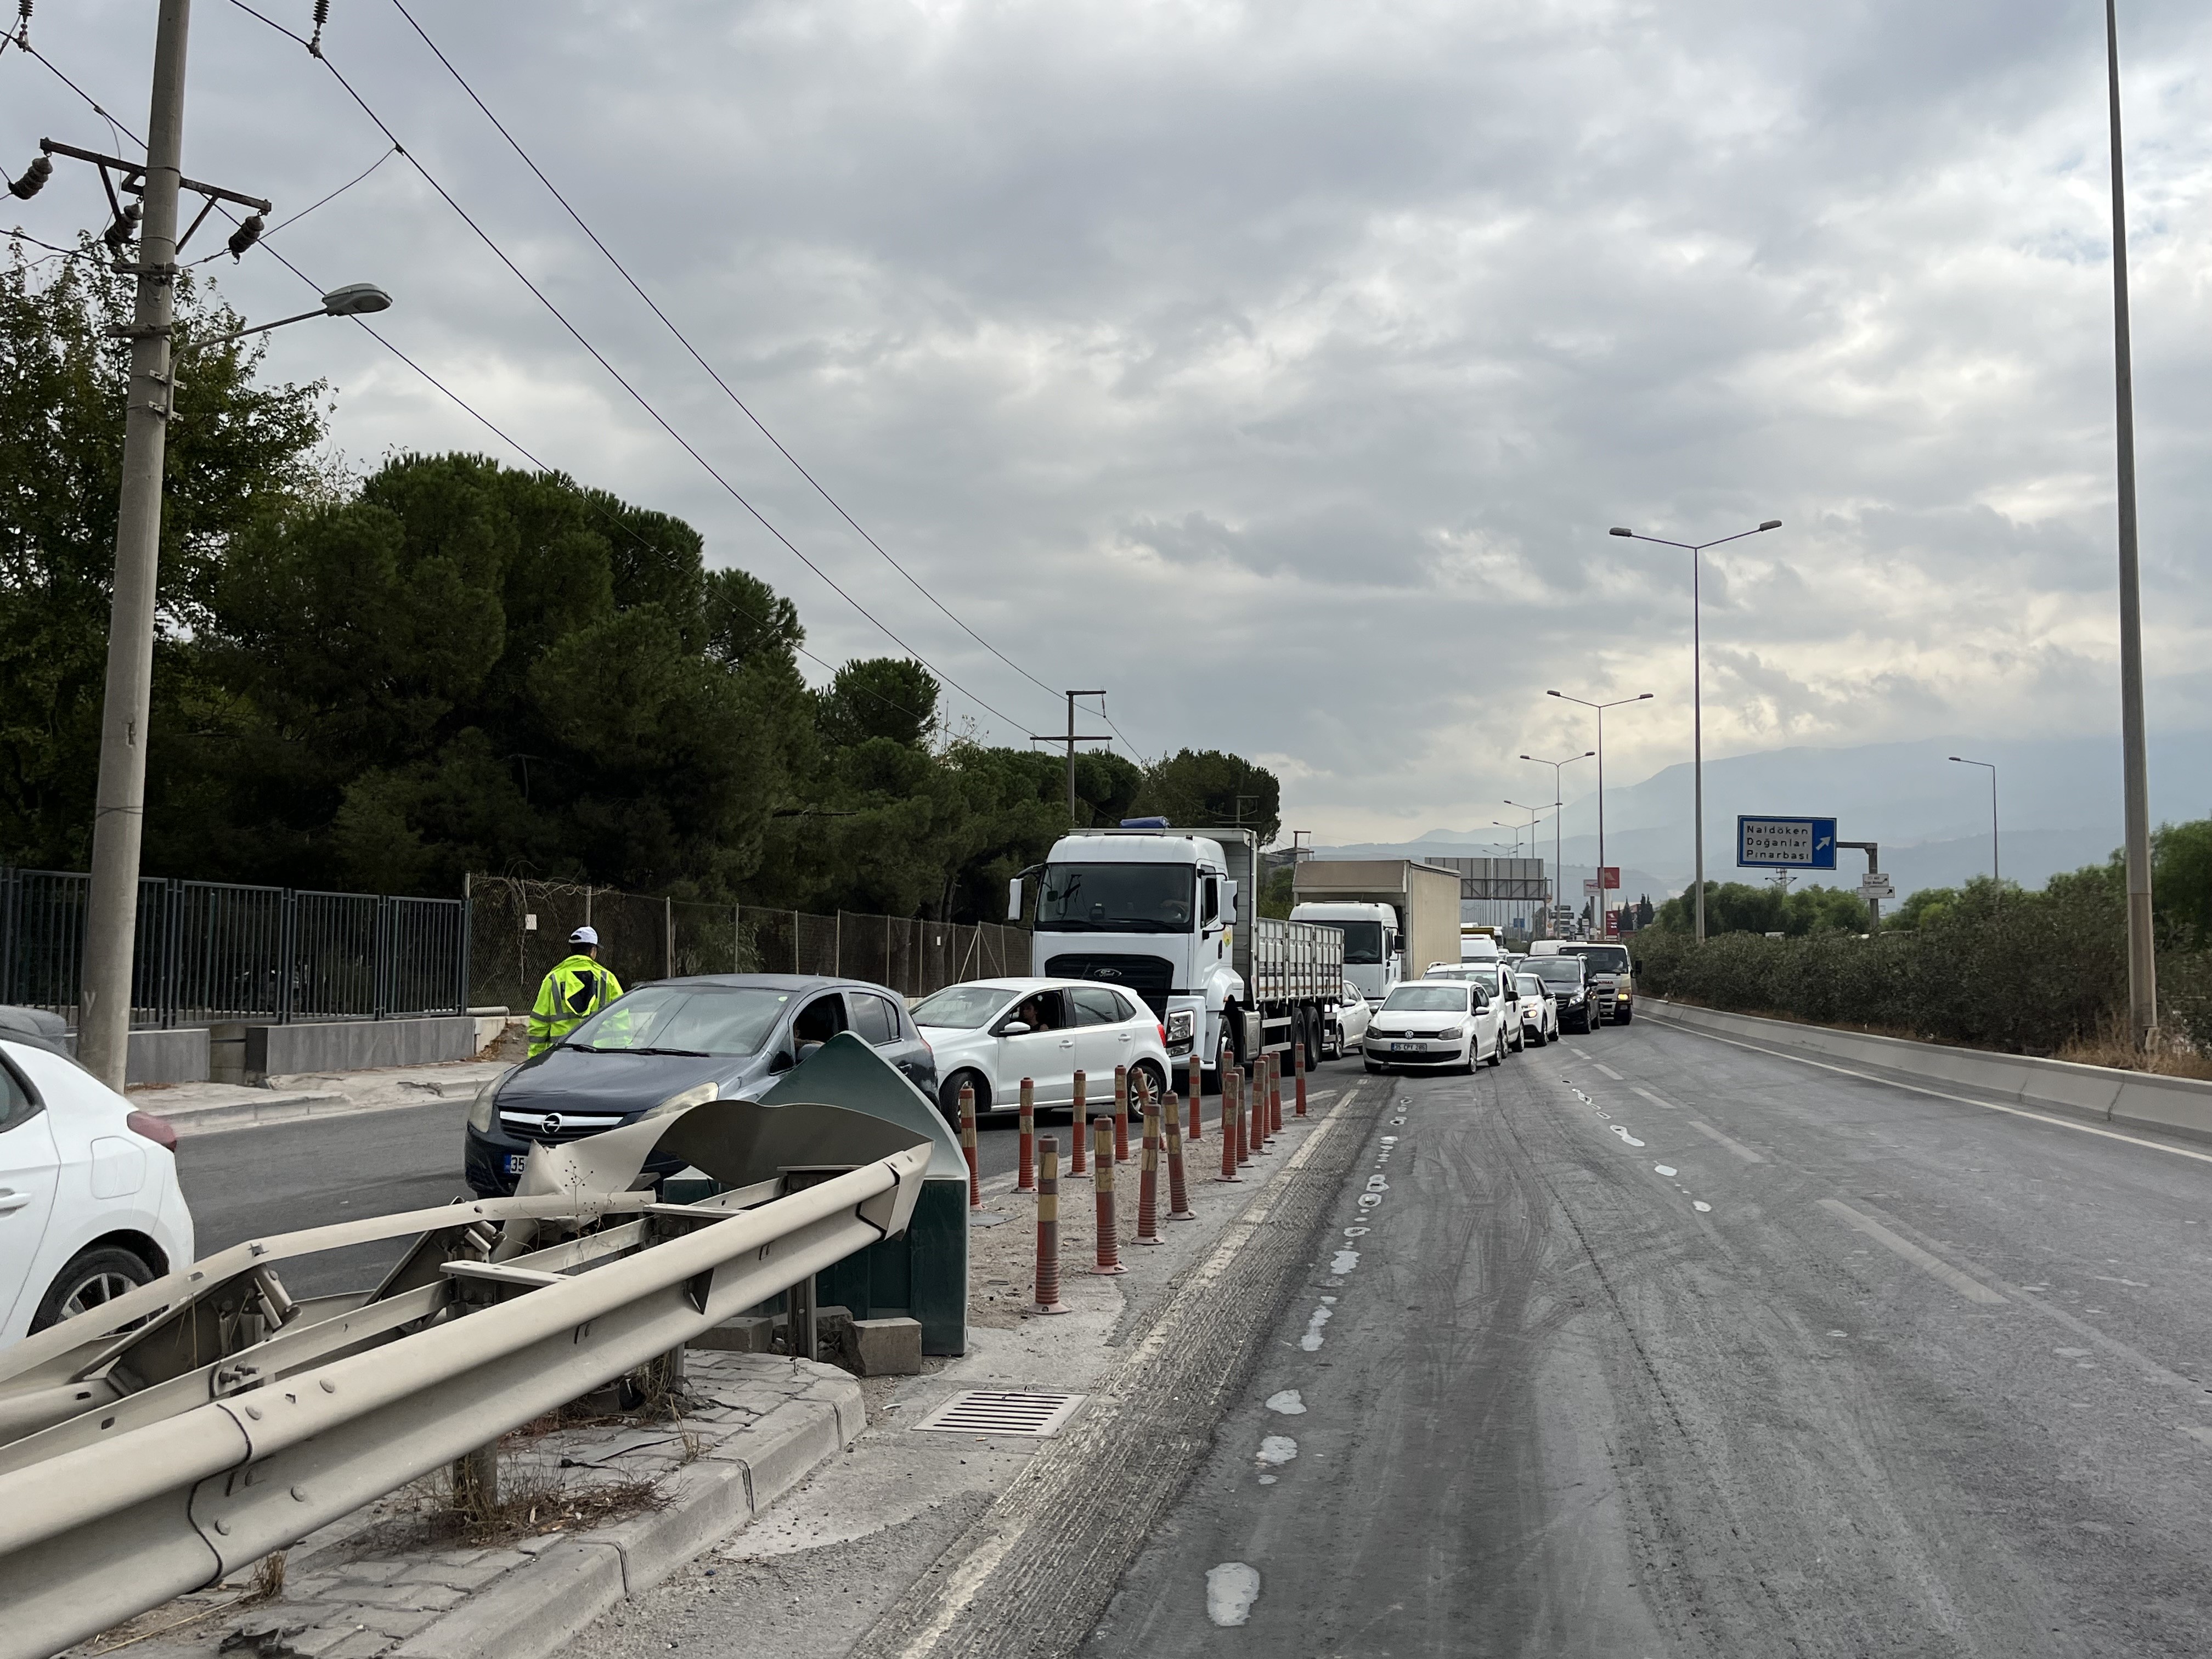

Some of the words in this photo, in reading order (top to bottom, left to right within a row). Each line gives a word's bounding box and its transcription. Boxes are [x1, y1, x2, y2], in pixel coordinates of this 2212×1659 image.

[1747, 825, 1808, 834] Naldöken
[1747, 837, 1807, 848] Doğanlar
[511, 1156, 525, 1172] 35
